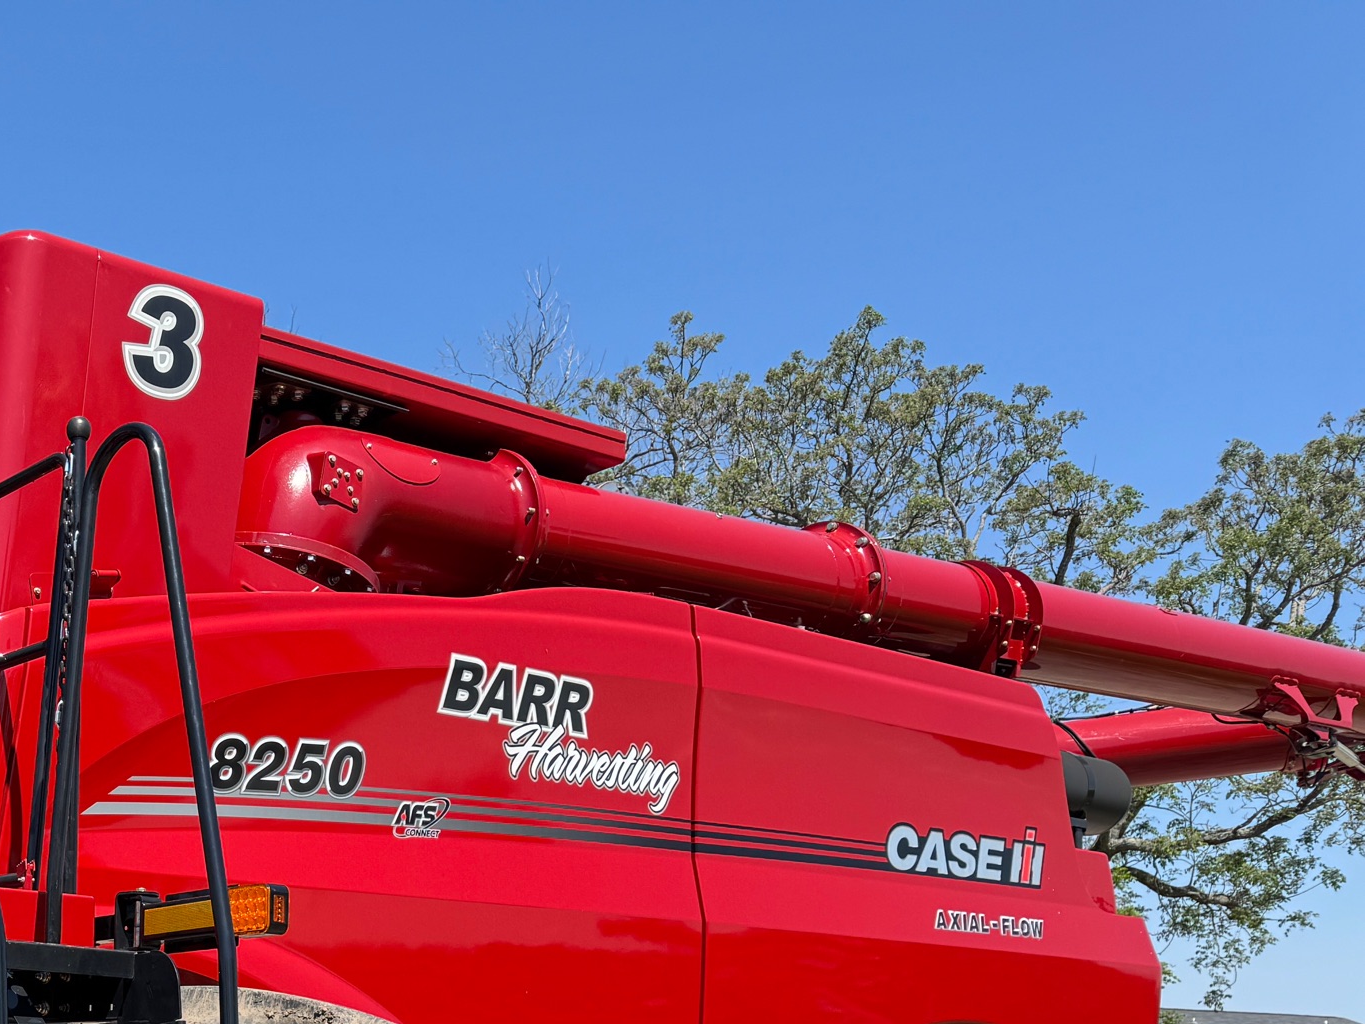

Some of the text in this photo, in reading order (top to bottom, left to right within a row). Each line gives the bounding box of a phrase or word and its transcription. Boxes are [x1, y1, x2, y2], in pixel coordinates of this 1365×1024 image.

[122, 284, 204, 400] 3
[437, 652, 593, 739] BARR
[210, 733, 366, 799] 8250
[504, 722, 680, 815] Harvesting
[392, 801, 439, 827] AFS
[405, 828, 441, 838] CONNECT
[886, 824, 1006, 882] CASE
[934, 909, 1044, 938] AXIAL-FLOW
